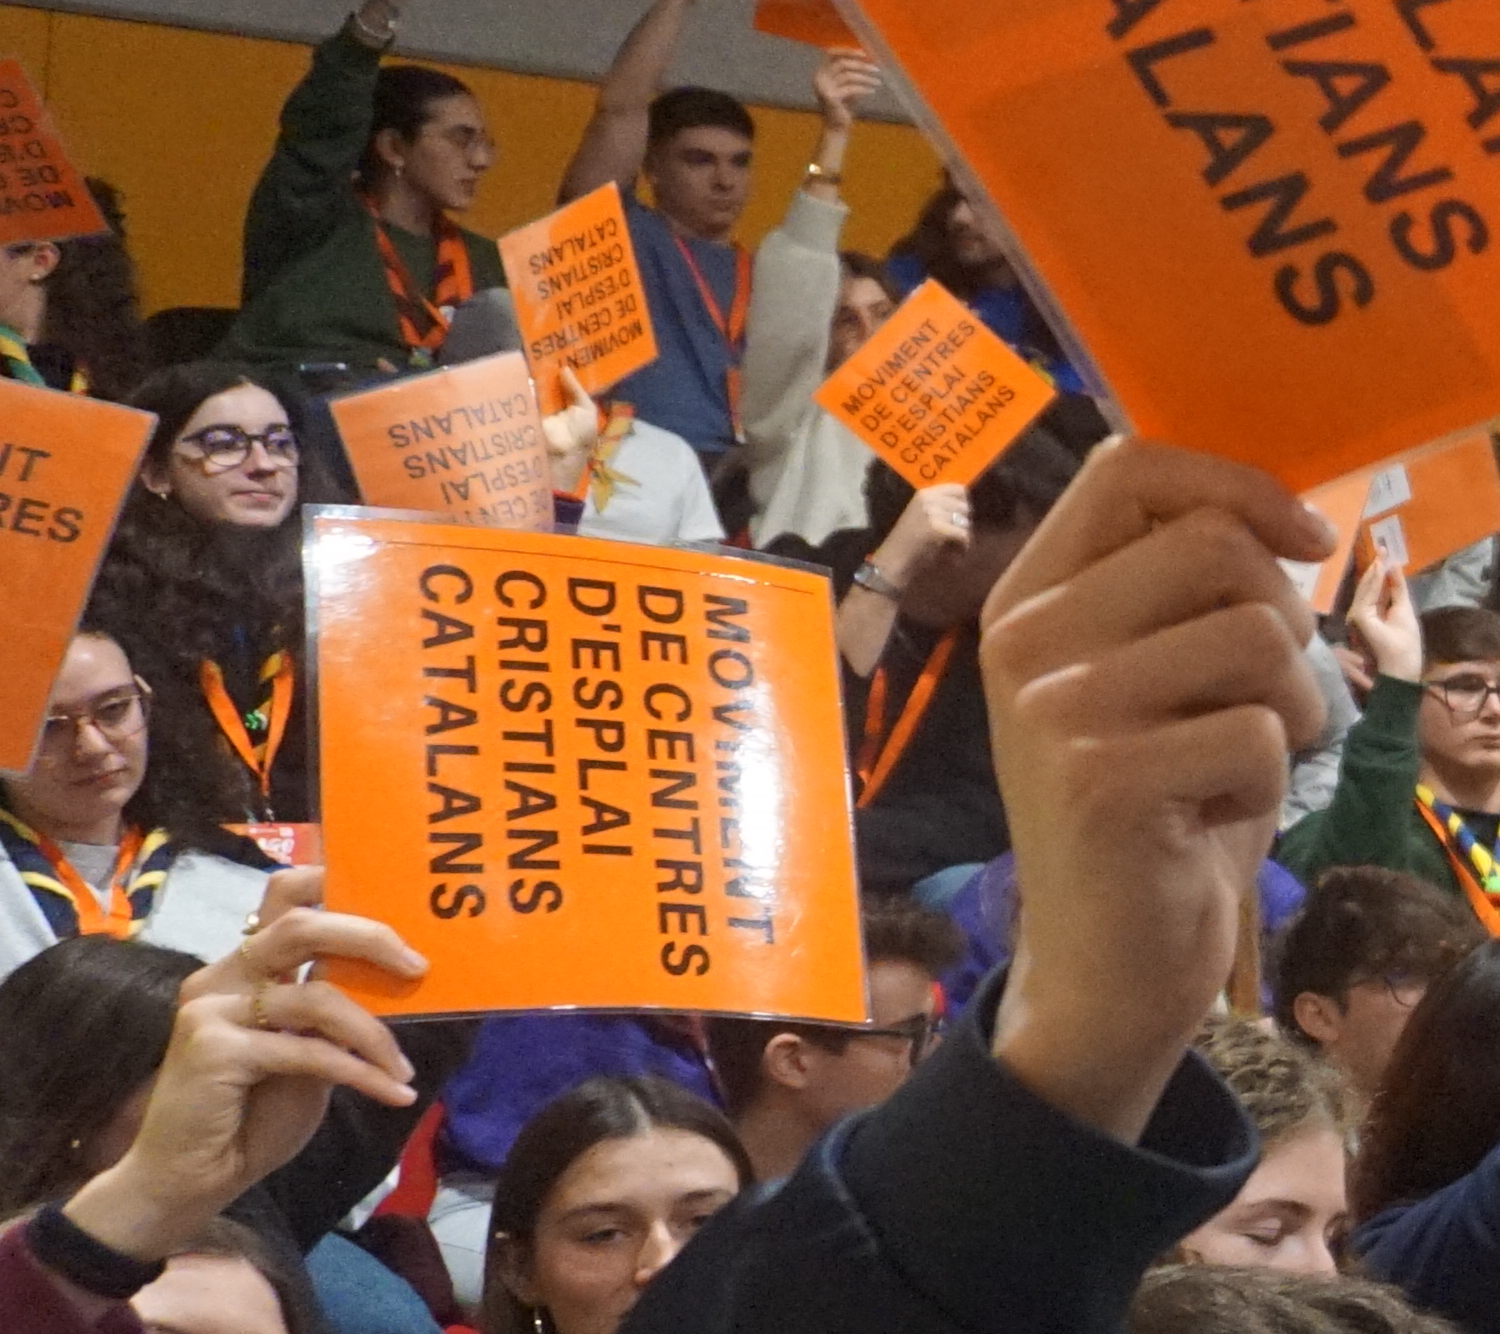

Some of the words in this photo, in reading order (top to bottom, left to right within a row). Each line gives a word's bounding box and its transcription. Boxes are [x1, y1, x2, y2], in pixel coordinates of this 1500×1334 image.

[528, 218, 618, 275] CATALANS
[537, 243, 624, 300] CRISTIANS
[530, 307, 613, 360] CENTRES
[615, 293, 637, 318] DE
[841, 318, 940, 416] MOVIMENT
[860, 403, 893, 433] DE
[890, 320, 976, 404] CENTRES
[387, 393, 528, 449] CATALANS
[403, 424, 537, 479] CRISTIANS
[900, 370, 996, 465] CRISTIANS
[919, 385, 1016, 481] CATALANS
[636, 585, 689, 666] DE
[418, 563, 488, 921] CATALANS
[493, 569, 564, 915] CRISTIANS
[642, 683, 711, 977] CENTRES
